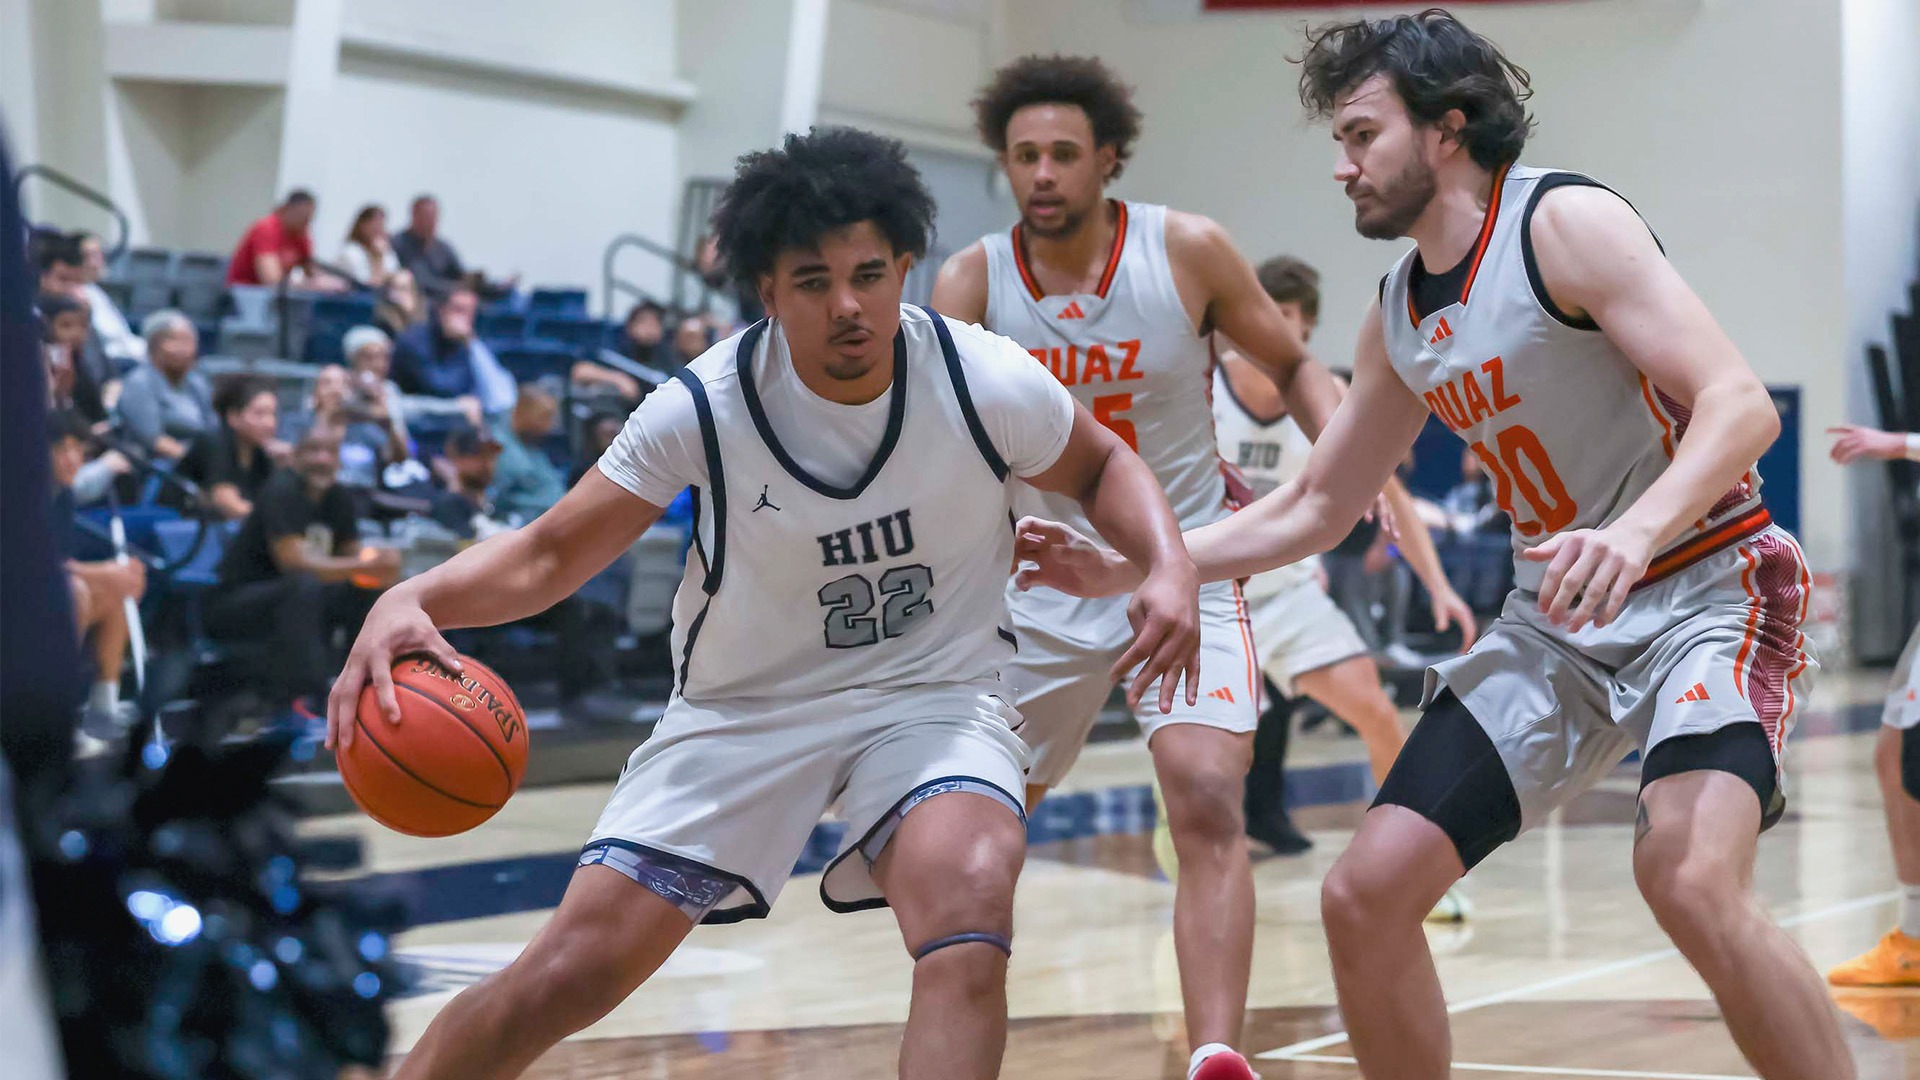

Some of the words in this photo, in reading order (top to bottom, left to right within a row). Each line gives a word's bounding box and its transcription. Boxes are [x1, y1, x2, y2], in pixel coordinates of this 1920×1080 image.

[1029, 339, 1144, 387] UAZ
[816, 508, 914, 567] HIU
[817, 564, 934, 649] 22
